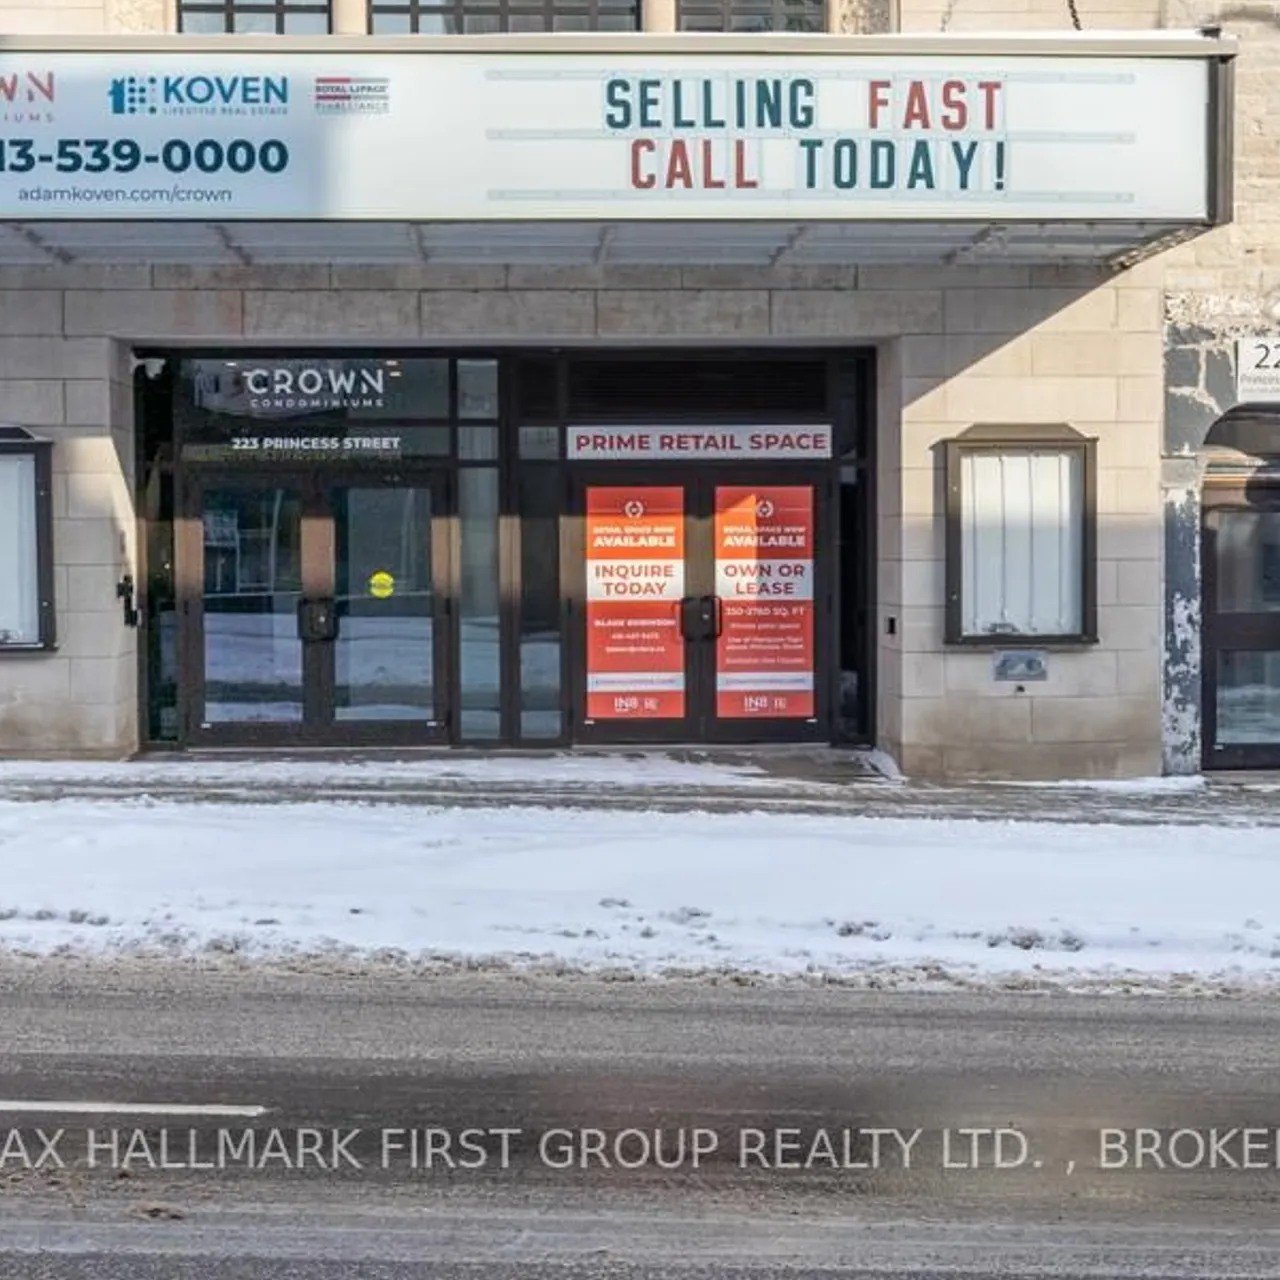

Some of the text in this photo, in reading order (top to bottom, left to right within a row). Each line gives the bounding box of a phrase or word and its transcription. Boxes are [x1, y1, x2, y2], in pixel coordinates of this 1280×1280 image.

[163, 76, 289, 104] KOVEN
[606, 79, 1002, 131] SELLING FAST
[631, 138, 1004, 191] CALL TODAY!
[18, 184, 232, 204] adamkoven.com/crown
[247, 368, 384, 394] CROWN
[250, 398, 384, 408] CONDOMINIUMS
[231, 436, 402, 450] 223 PRINCESS STREET
[576, 433, 827, 451] PRIME RETAIL SPACE
[593, 536, 675, 548] AVAILABLE
[723, 536, 805, 548] AVAILABLE
[595, 564, 674, 578] INQUIRE
[724, 564, 805, 577] OWN OR
[603, 582, 666, 595] TODAY
[736, 582, 794, 595] LEASE
